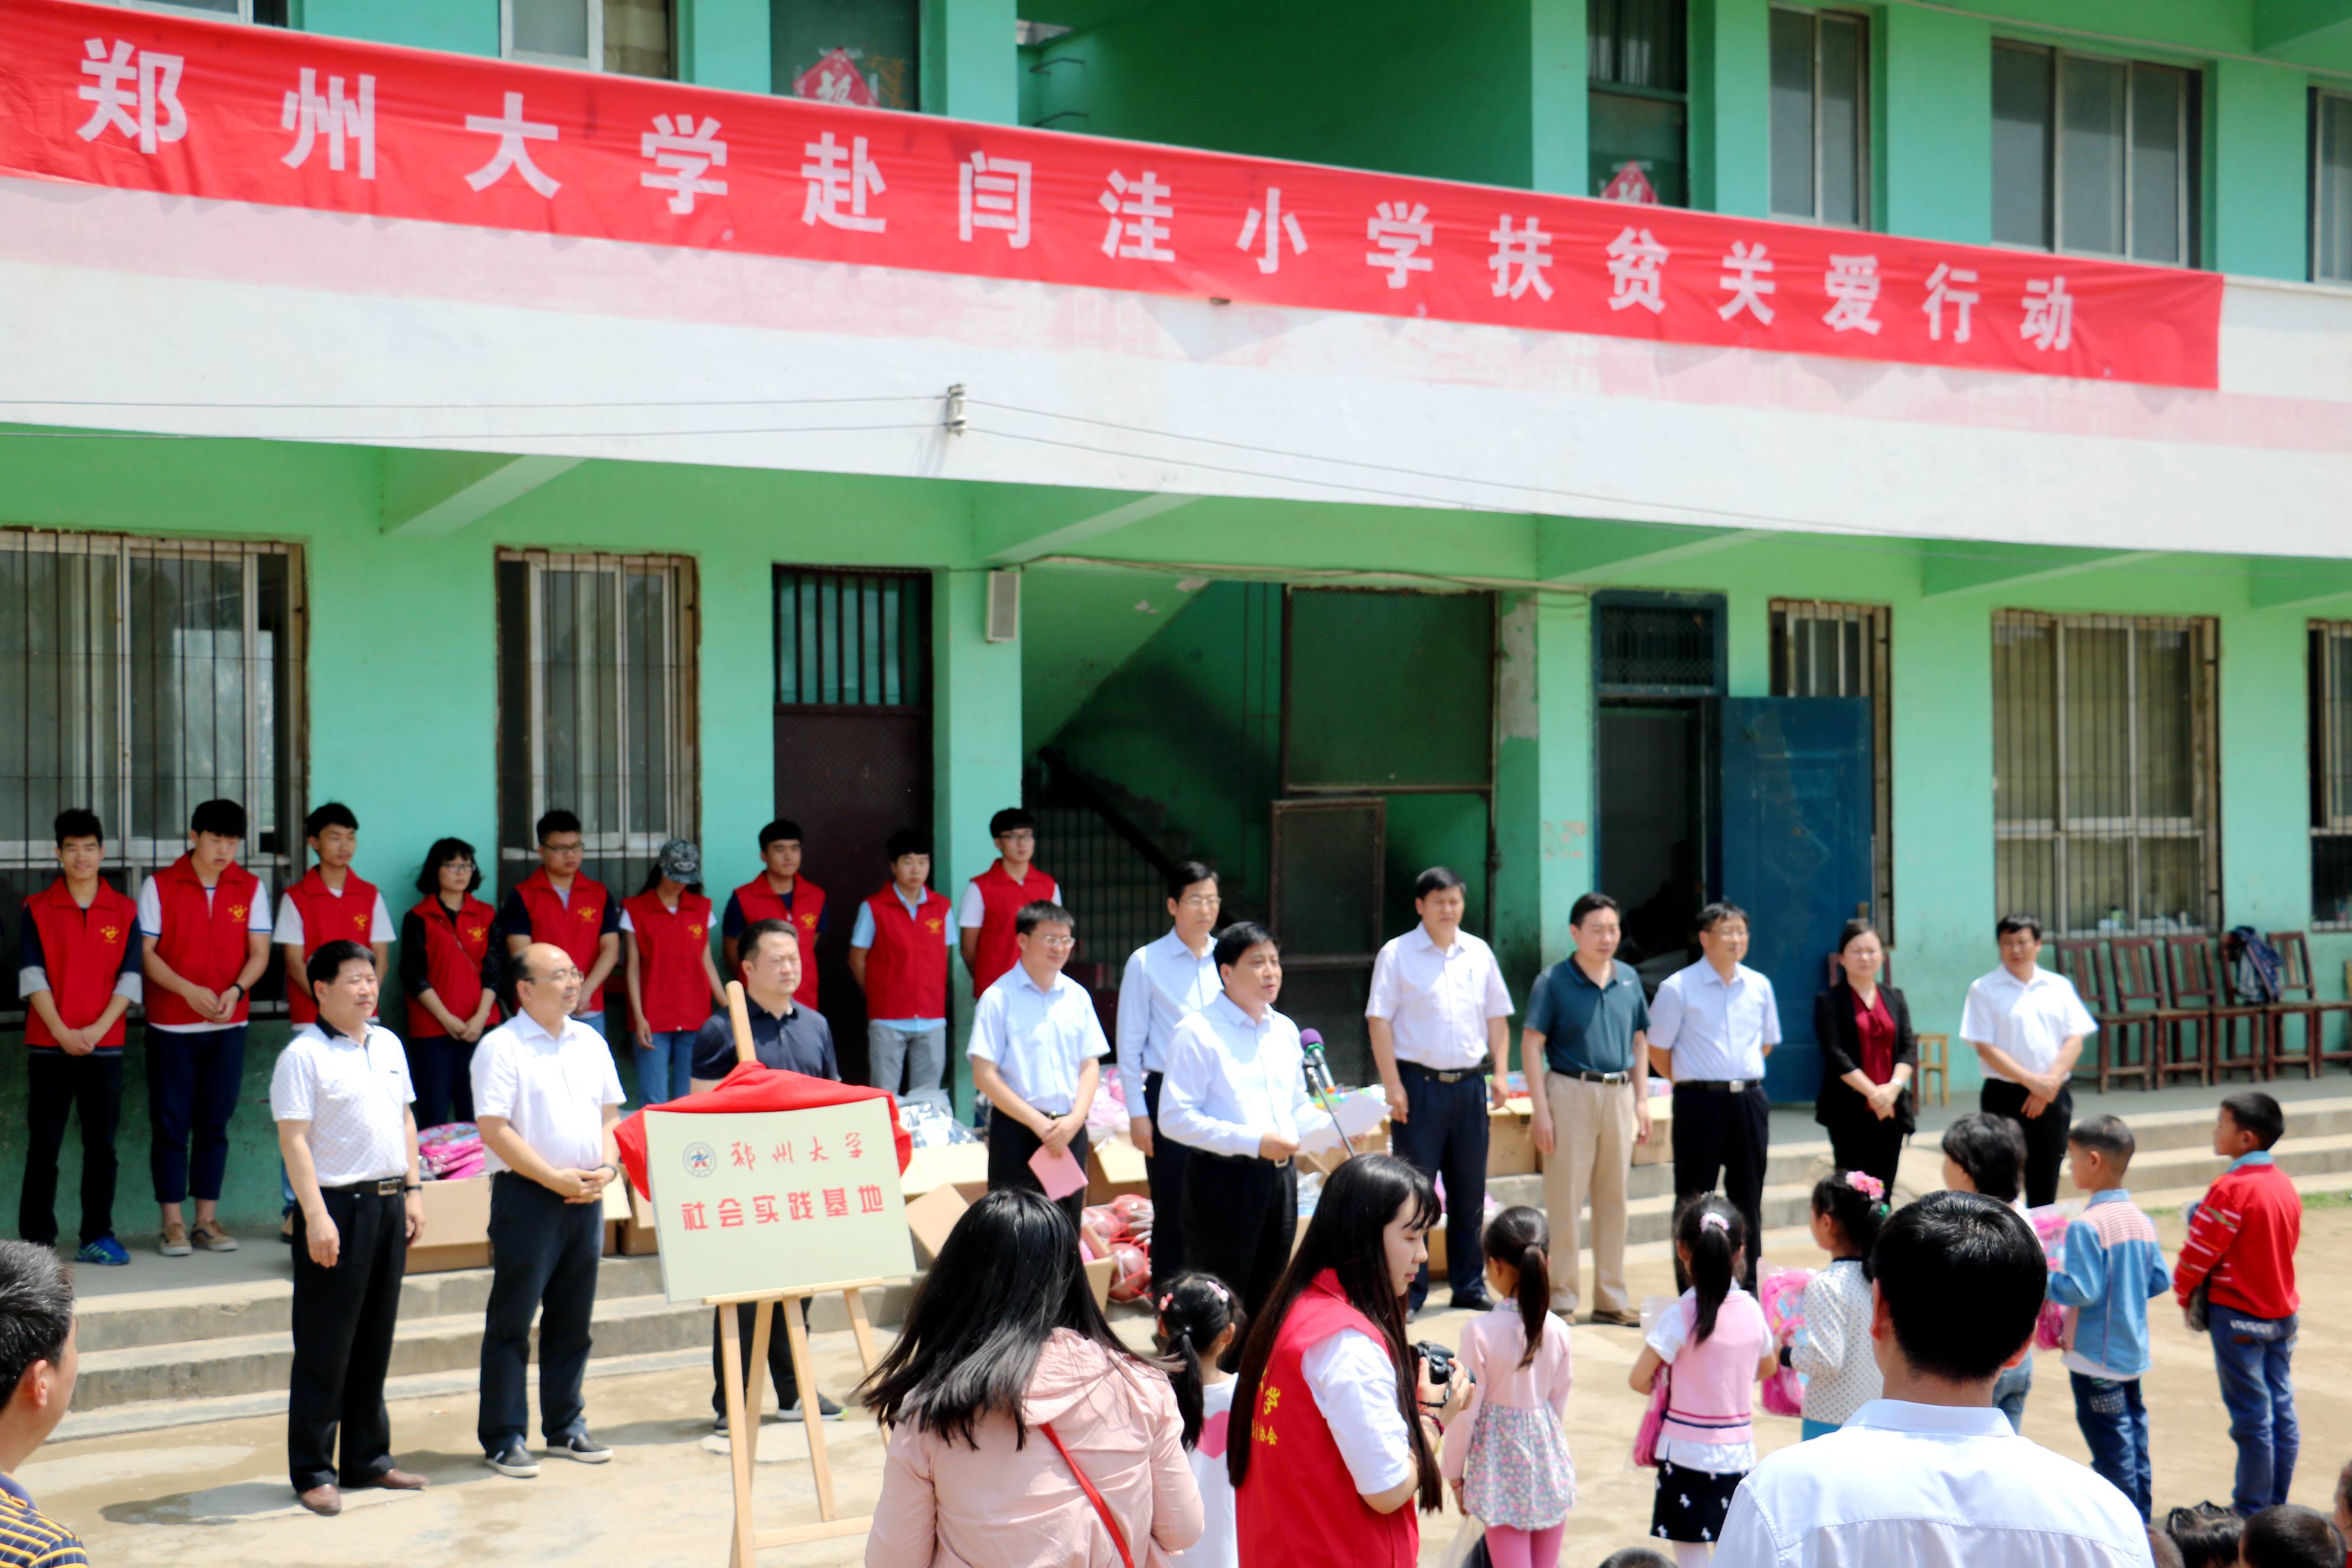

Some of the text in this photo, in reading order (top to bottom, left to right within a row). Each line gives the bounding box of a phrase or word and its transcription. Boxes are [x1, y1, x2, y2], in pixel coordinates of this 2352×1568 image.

[77, 37, 2074, 352] 郑州大学赴闫洼小学扶贫关爱行动
[731, 1132, 864, 1171] 郑州大学
[681, 1184, 884, 1231] 社会实践基地
